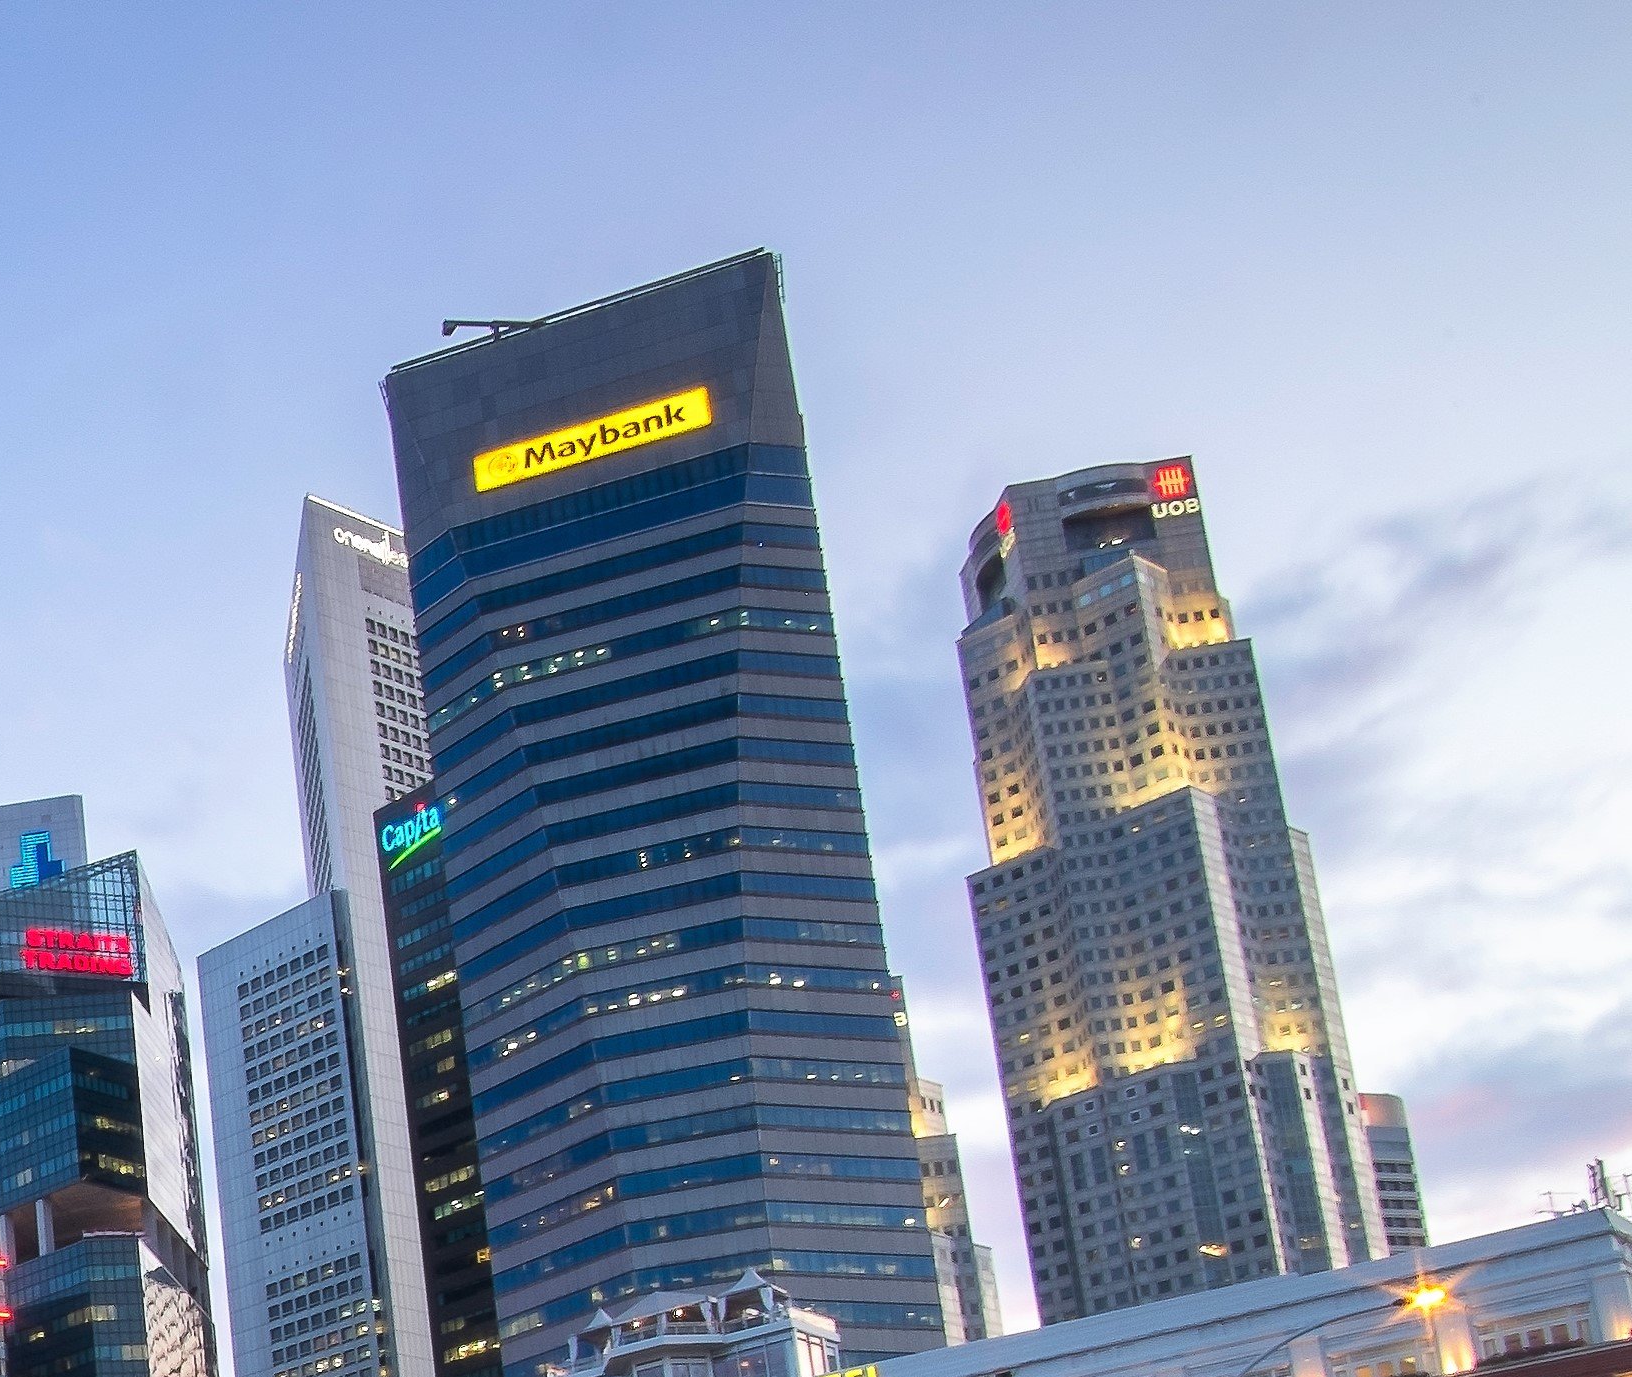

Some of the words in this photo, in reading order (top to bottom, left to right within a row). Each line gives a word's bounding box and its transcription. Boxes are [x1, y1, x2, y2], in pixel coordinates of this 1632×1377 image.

[524, 403, 686, 468] Maybank
[1151, 498, 1201, 519] UOB
[381, 804, 440, 852] Capita
[26, 928, 131, 954] STRAITS
[21, 949, 134, 977] TRADING
